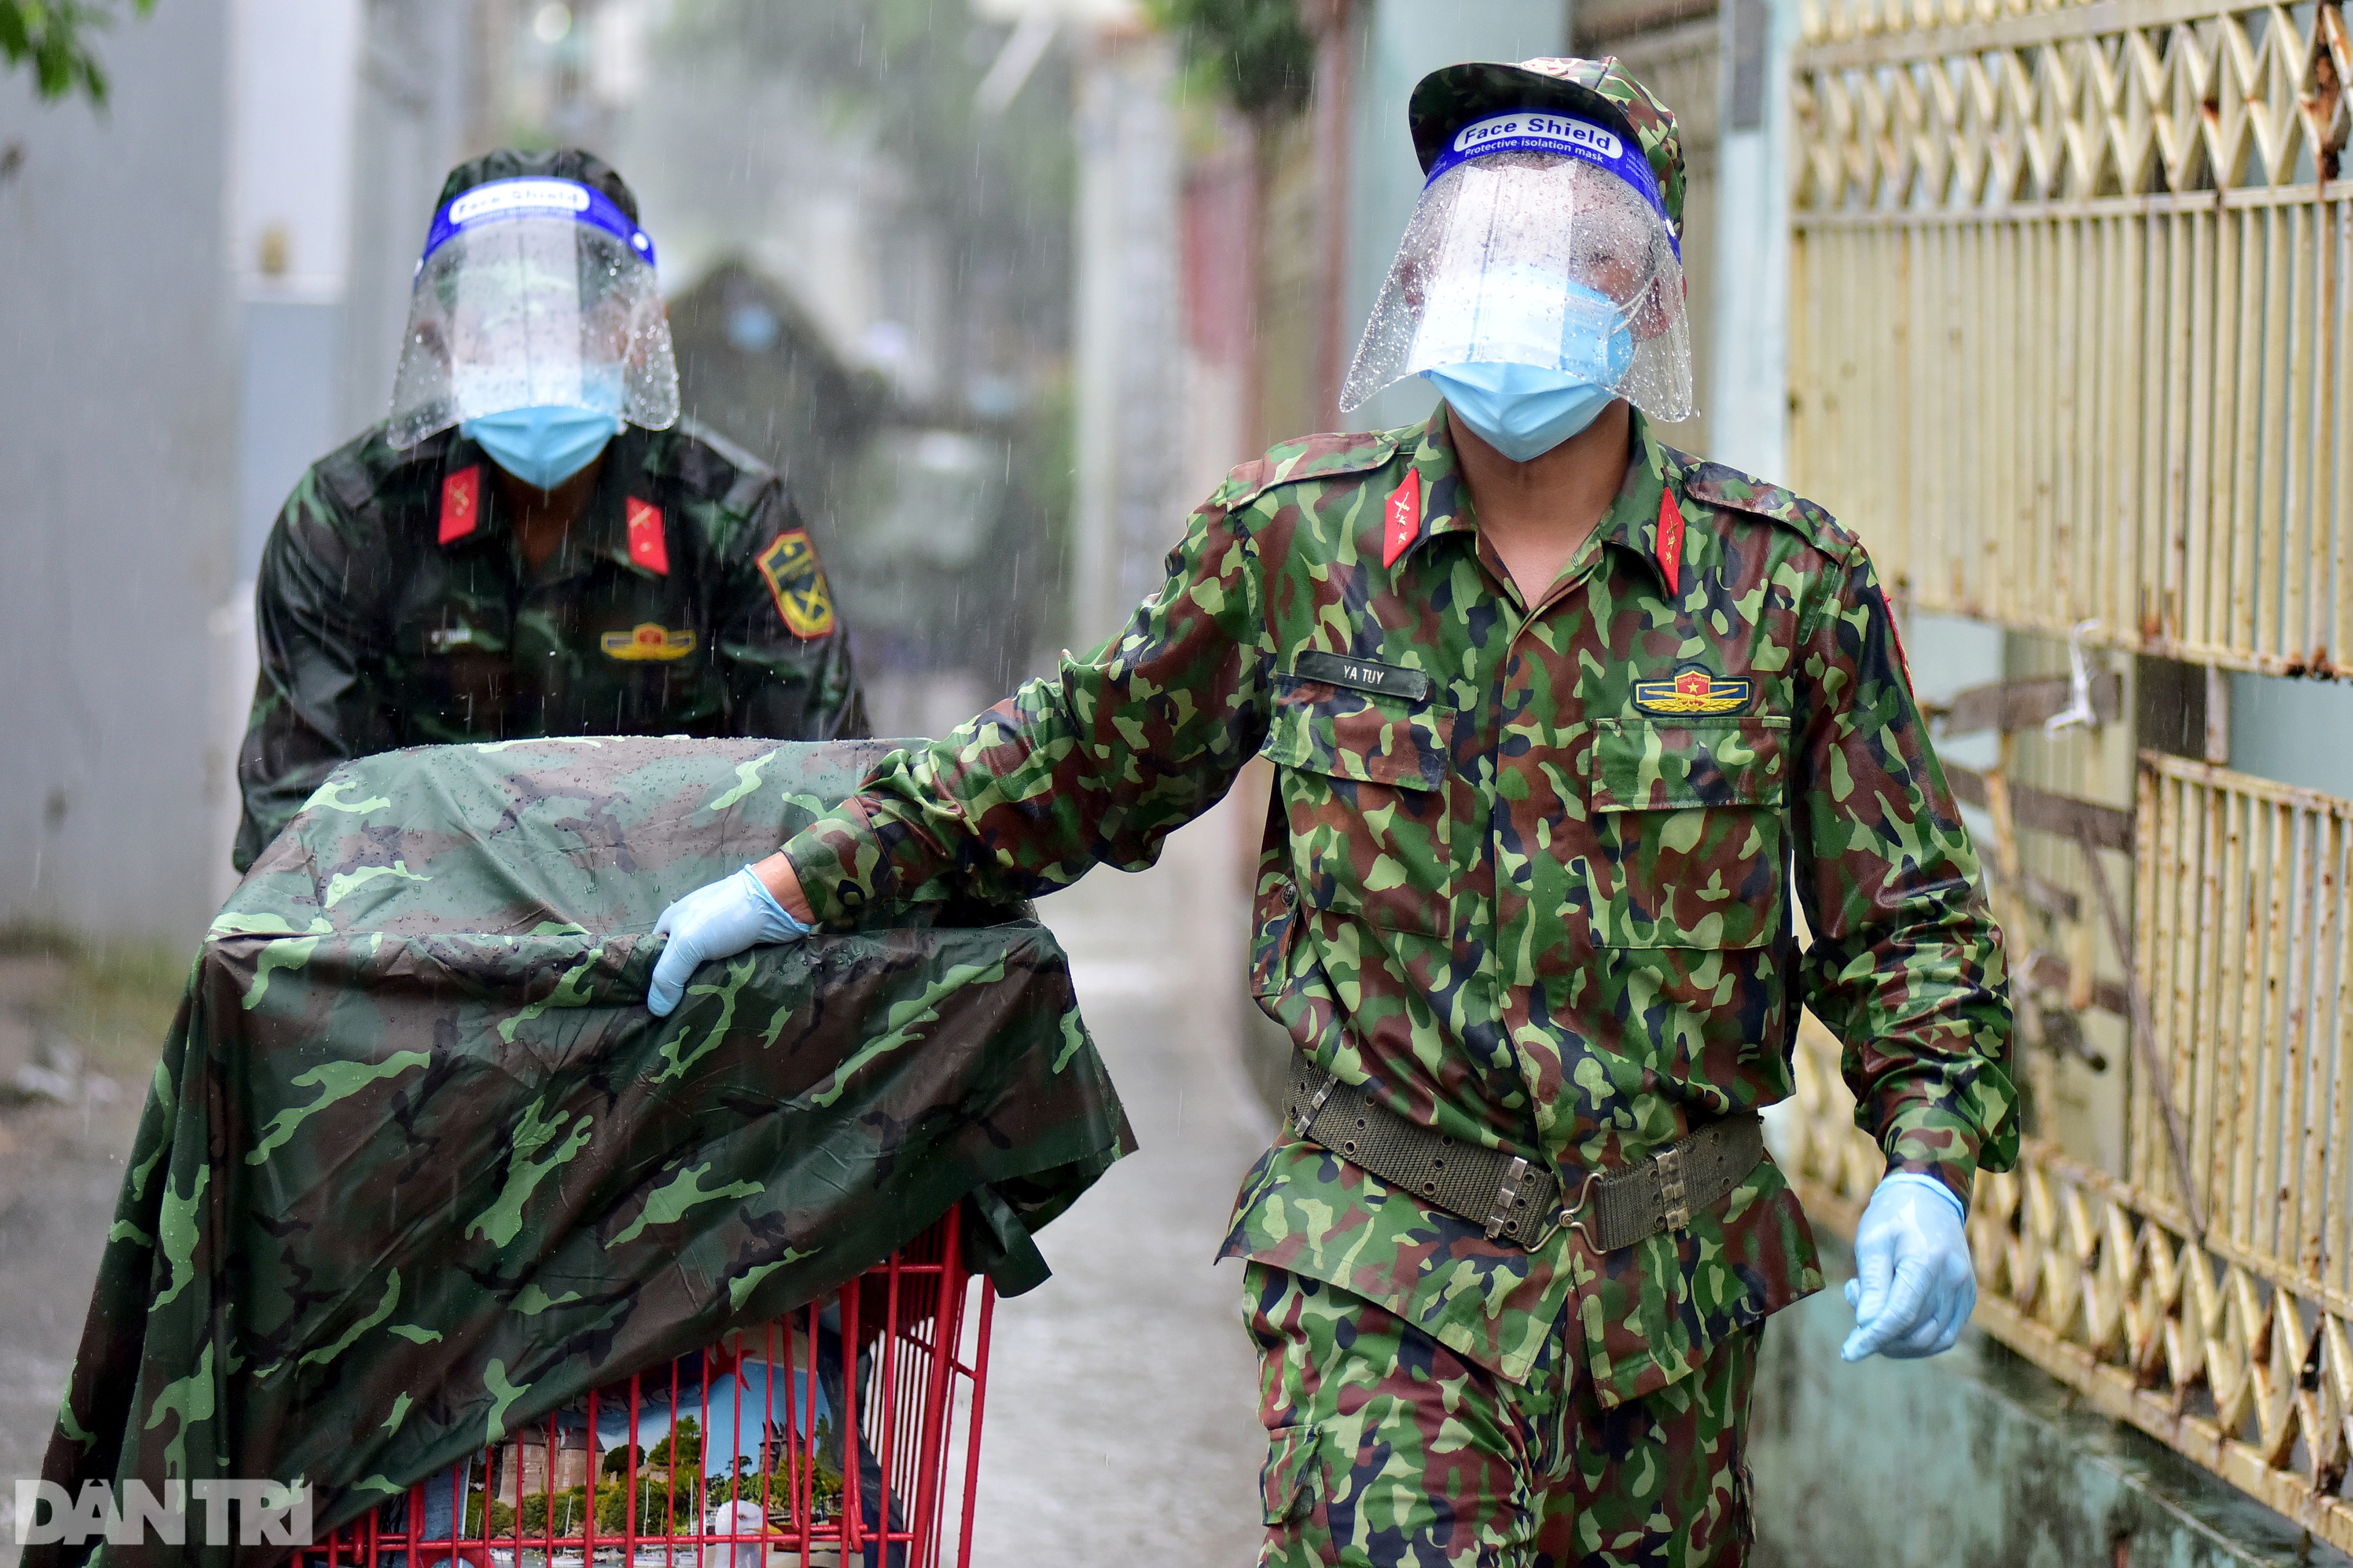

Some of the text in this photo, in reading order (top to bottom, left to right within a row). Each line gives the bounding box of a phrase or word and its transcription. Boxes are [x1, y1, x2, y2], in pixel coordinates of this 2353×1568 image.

[1464, 118, 1611, 151] Face Shield
[1464, 137, 1604, 164] Protective isolation mask
[1344, 665, 1385, 685] YA TUY
